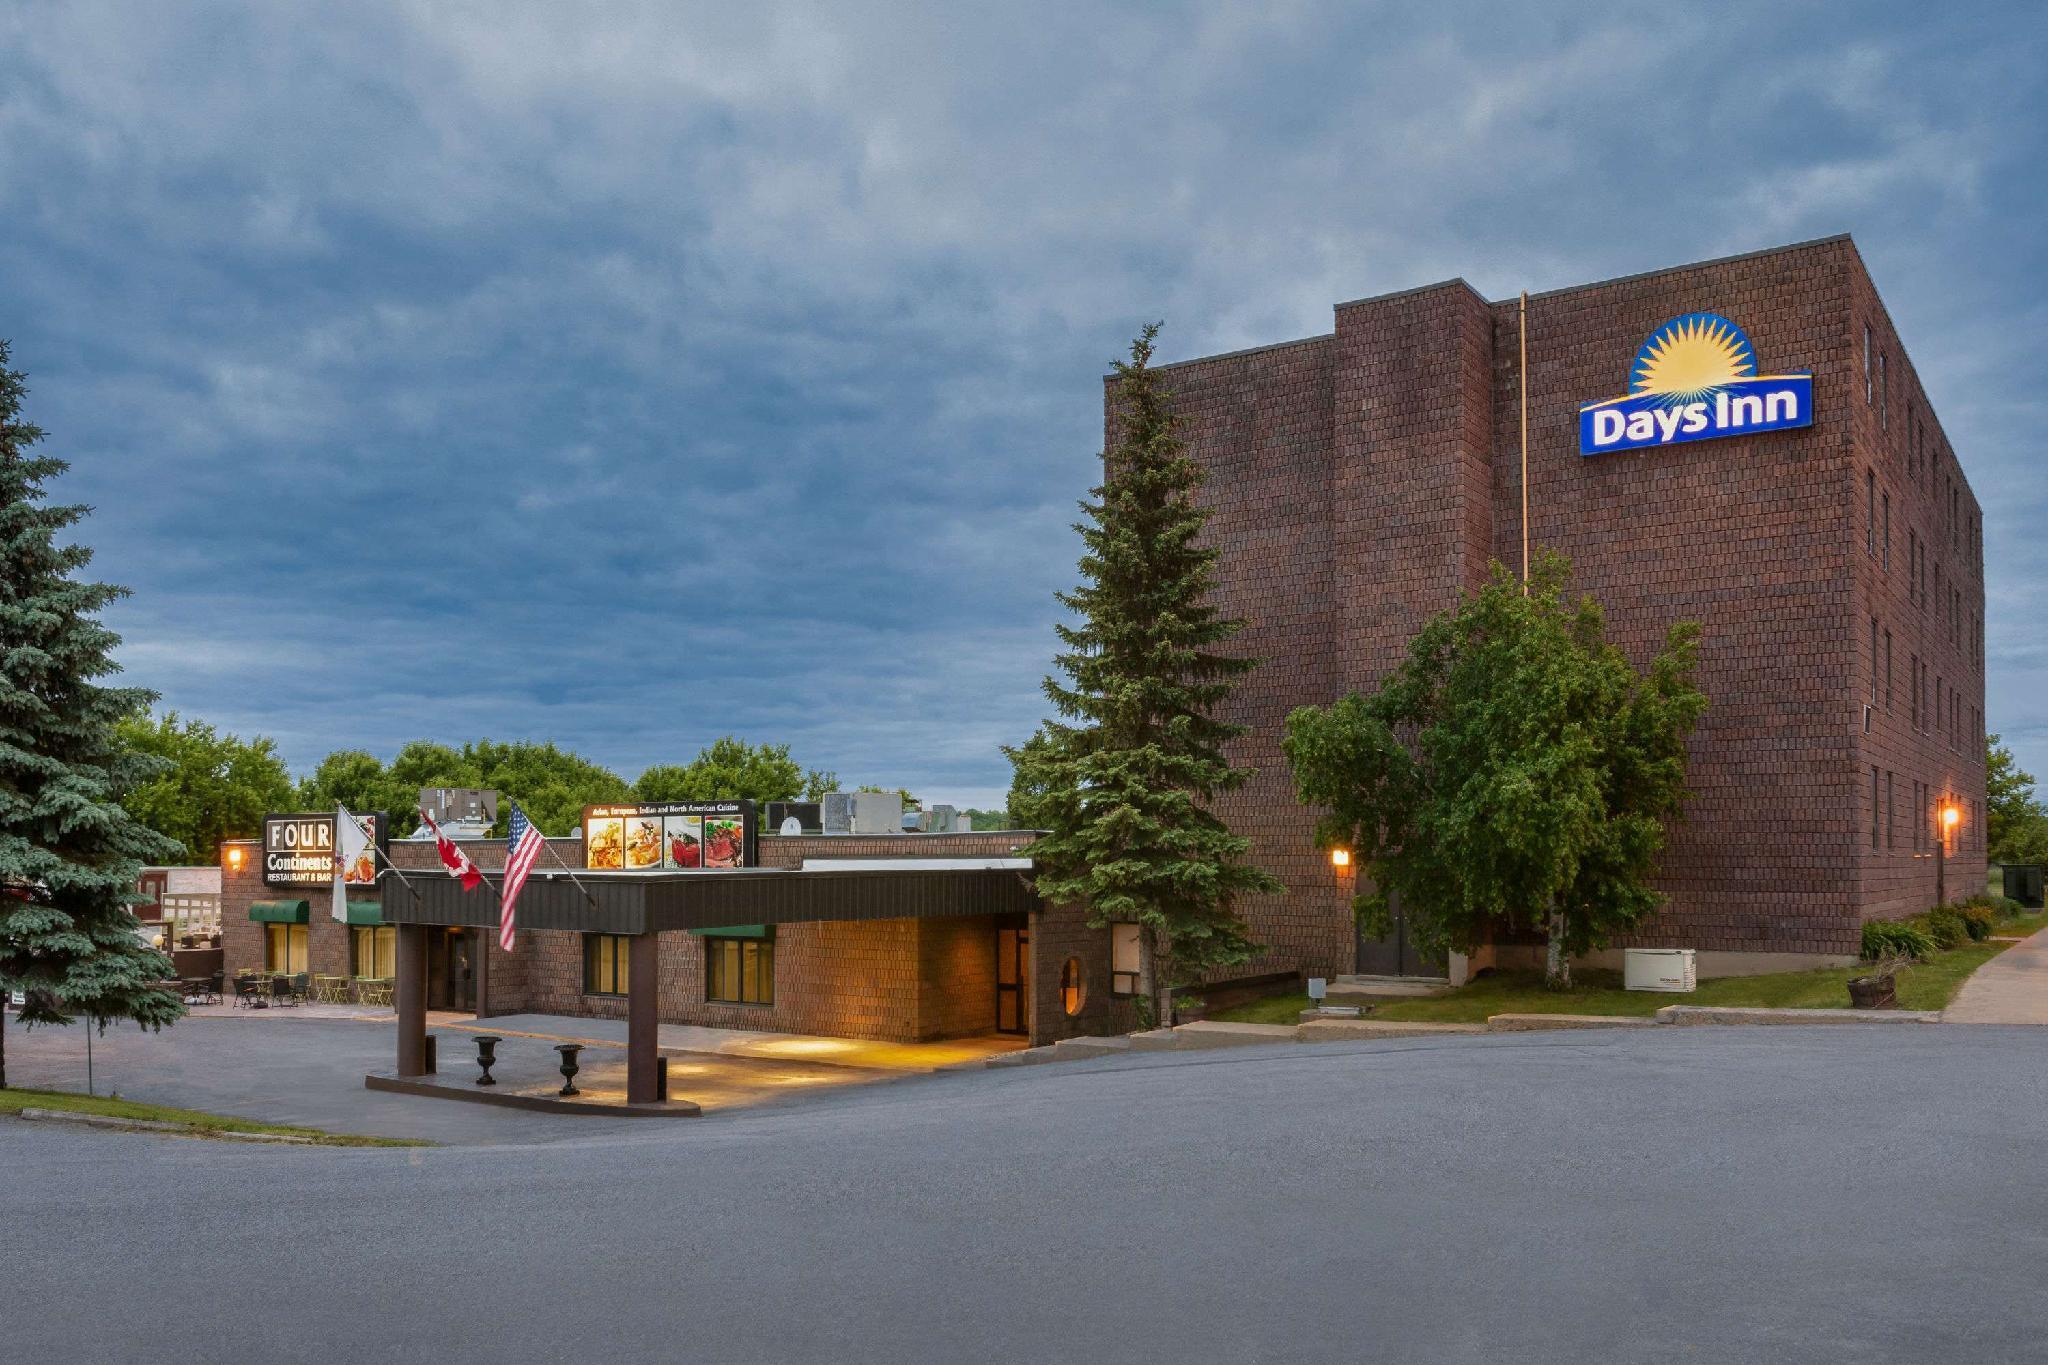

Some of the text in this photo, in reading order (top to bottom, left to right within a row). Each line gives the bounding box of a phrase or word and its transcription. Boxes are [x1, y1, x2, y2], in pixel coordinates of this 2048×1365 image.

[1594, 391, 1797, 446] Days Inn
[639, 806, 656, 814] Indian
[657, 805, 668, 813] and
[669, 804, 687, 812] North
[688, 803, 716, 812] American
[716, 802, 739, 811] Cuisine
[271, 823, 331, 847] FOUR
[267, 852, 332, 871] Continents
[267, 873, 332, 881] RESTAURANT & BAR
